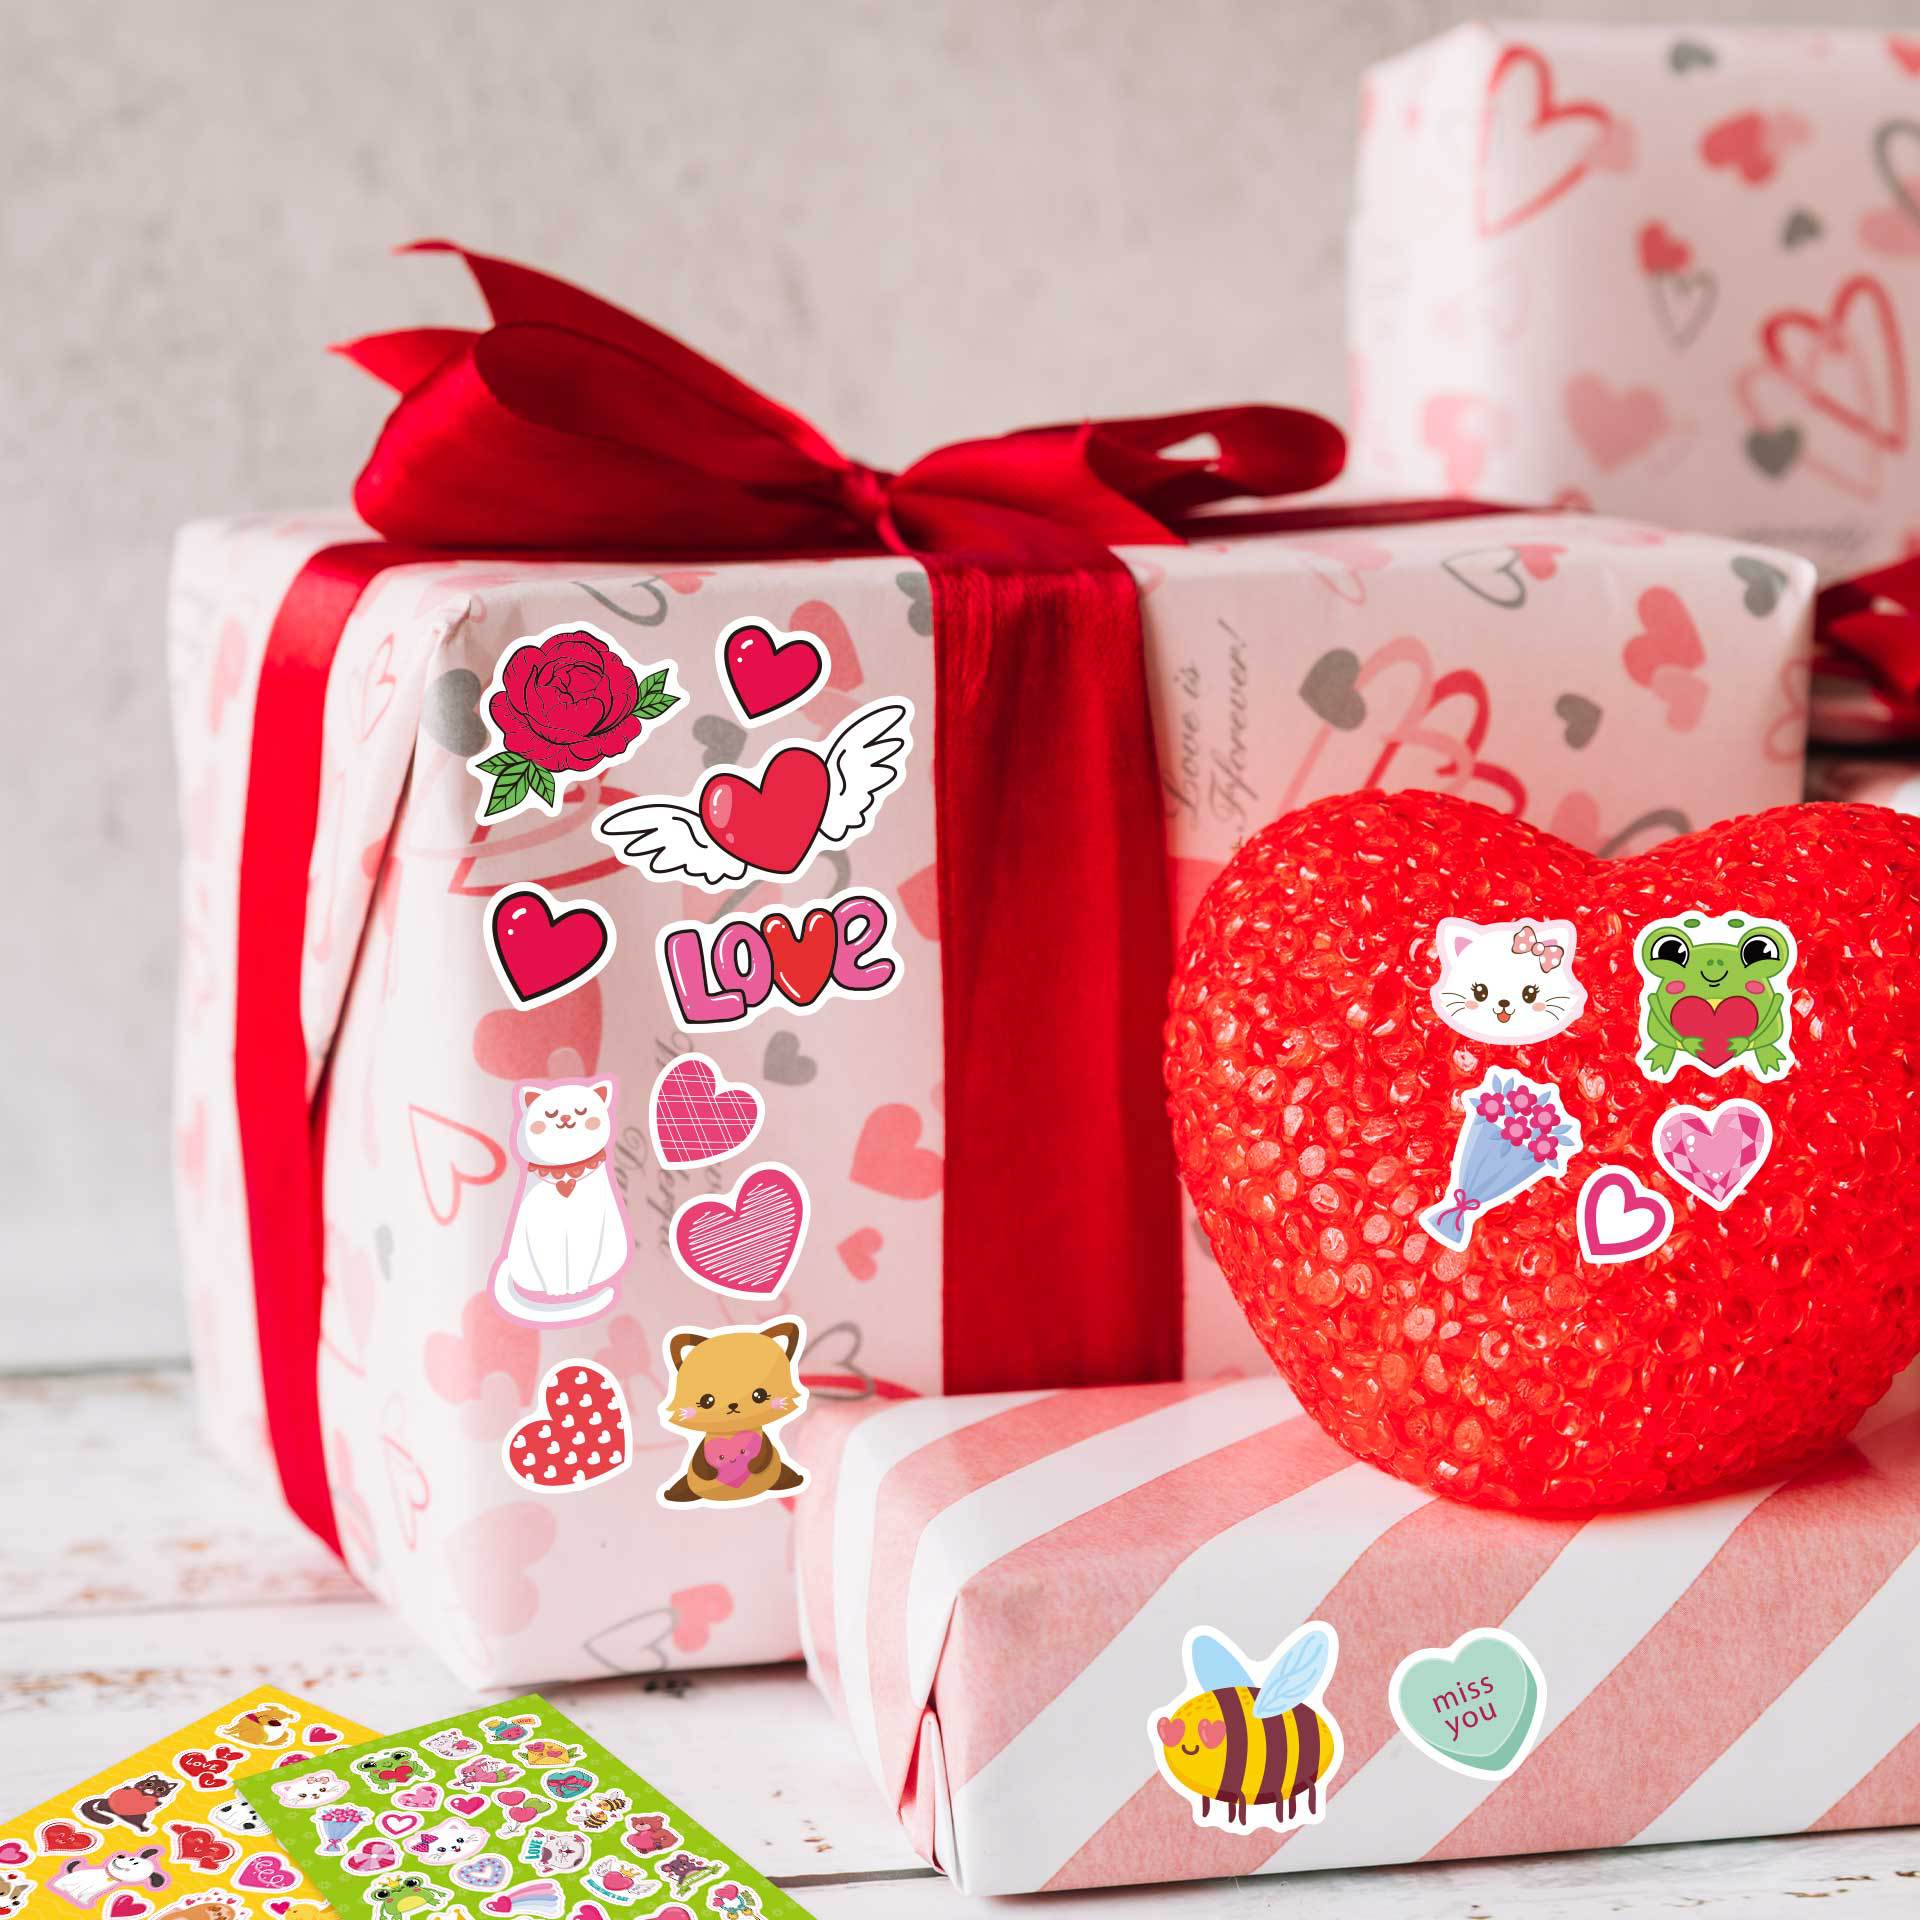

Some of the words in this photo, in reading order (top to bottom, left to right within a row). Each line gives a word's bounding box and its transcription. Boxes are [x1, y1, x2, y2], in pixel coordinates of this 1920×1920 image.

[1174, 661, 1201, 699] is
[1432, 1676, 1494, 1713] miss
[1444, 1702, 1497, 1742] you
[525, 1839, 543, 1860] LOVE
